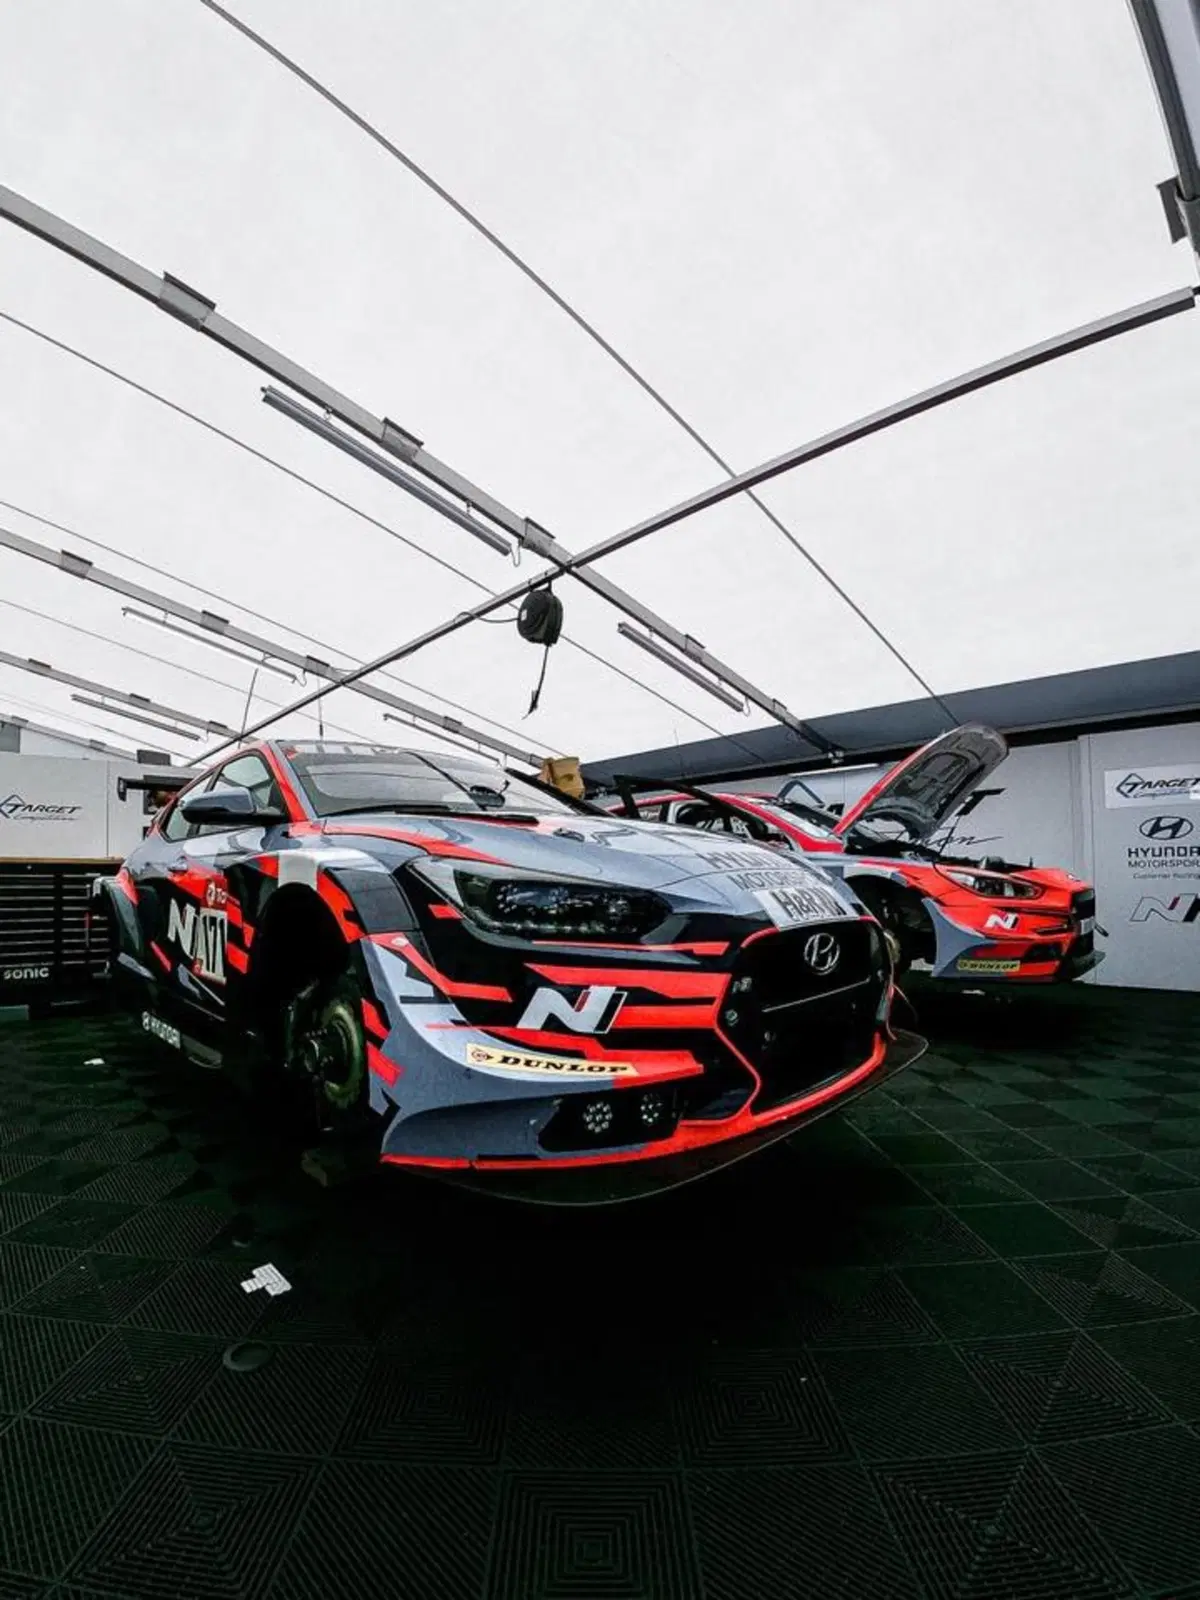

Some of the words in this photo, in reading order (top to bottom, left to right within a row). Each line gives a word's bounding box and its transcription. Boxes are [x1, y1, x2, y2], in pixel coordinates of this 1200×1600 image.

[1125, 777, 1200, 793] TARGET
[6, 802, 83, 814] TARGET
[1128, 846, 1200, 857] HYUNDA
[497, 1054, 628, 1073] DUNLOP
